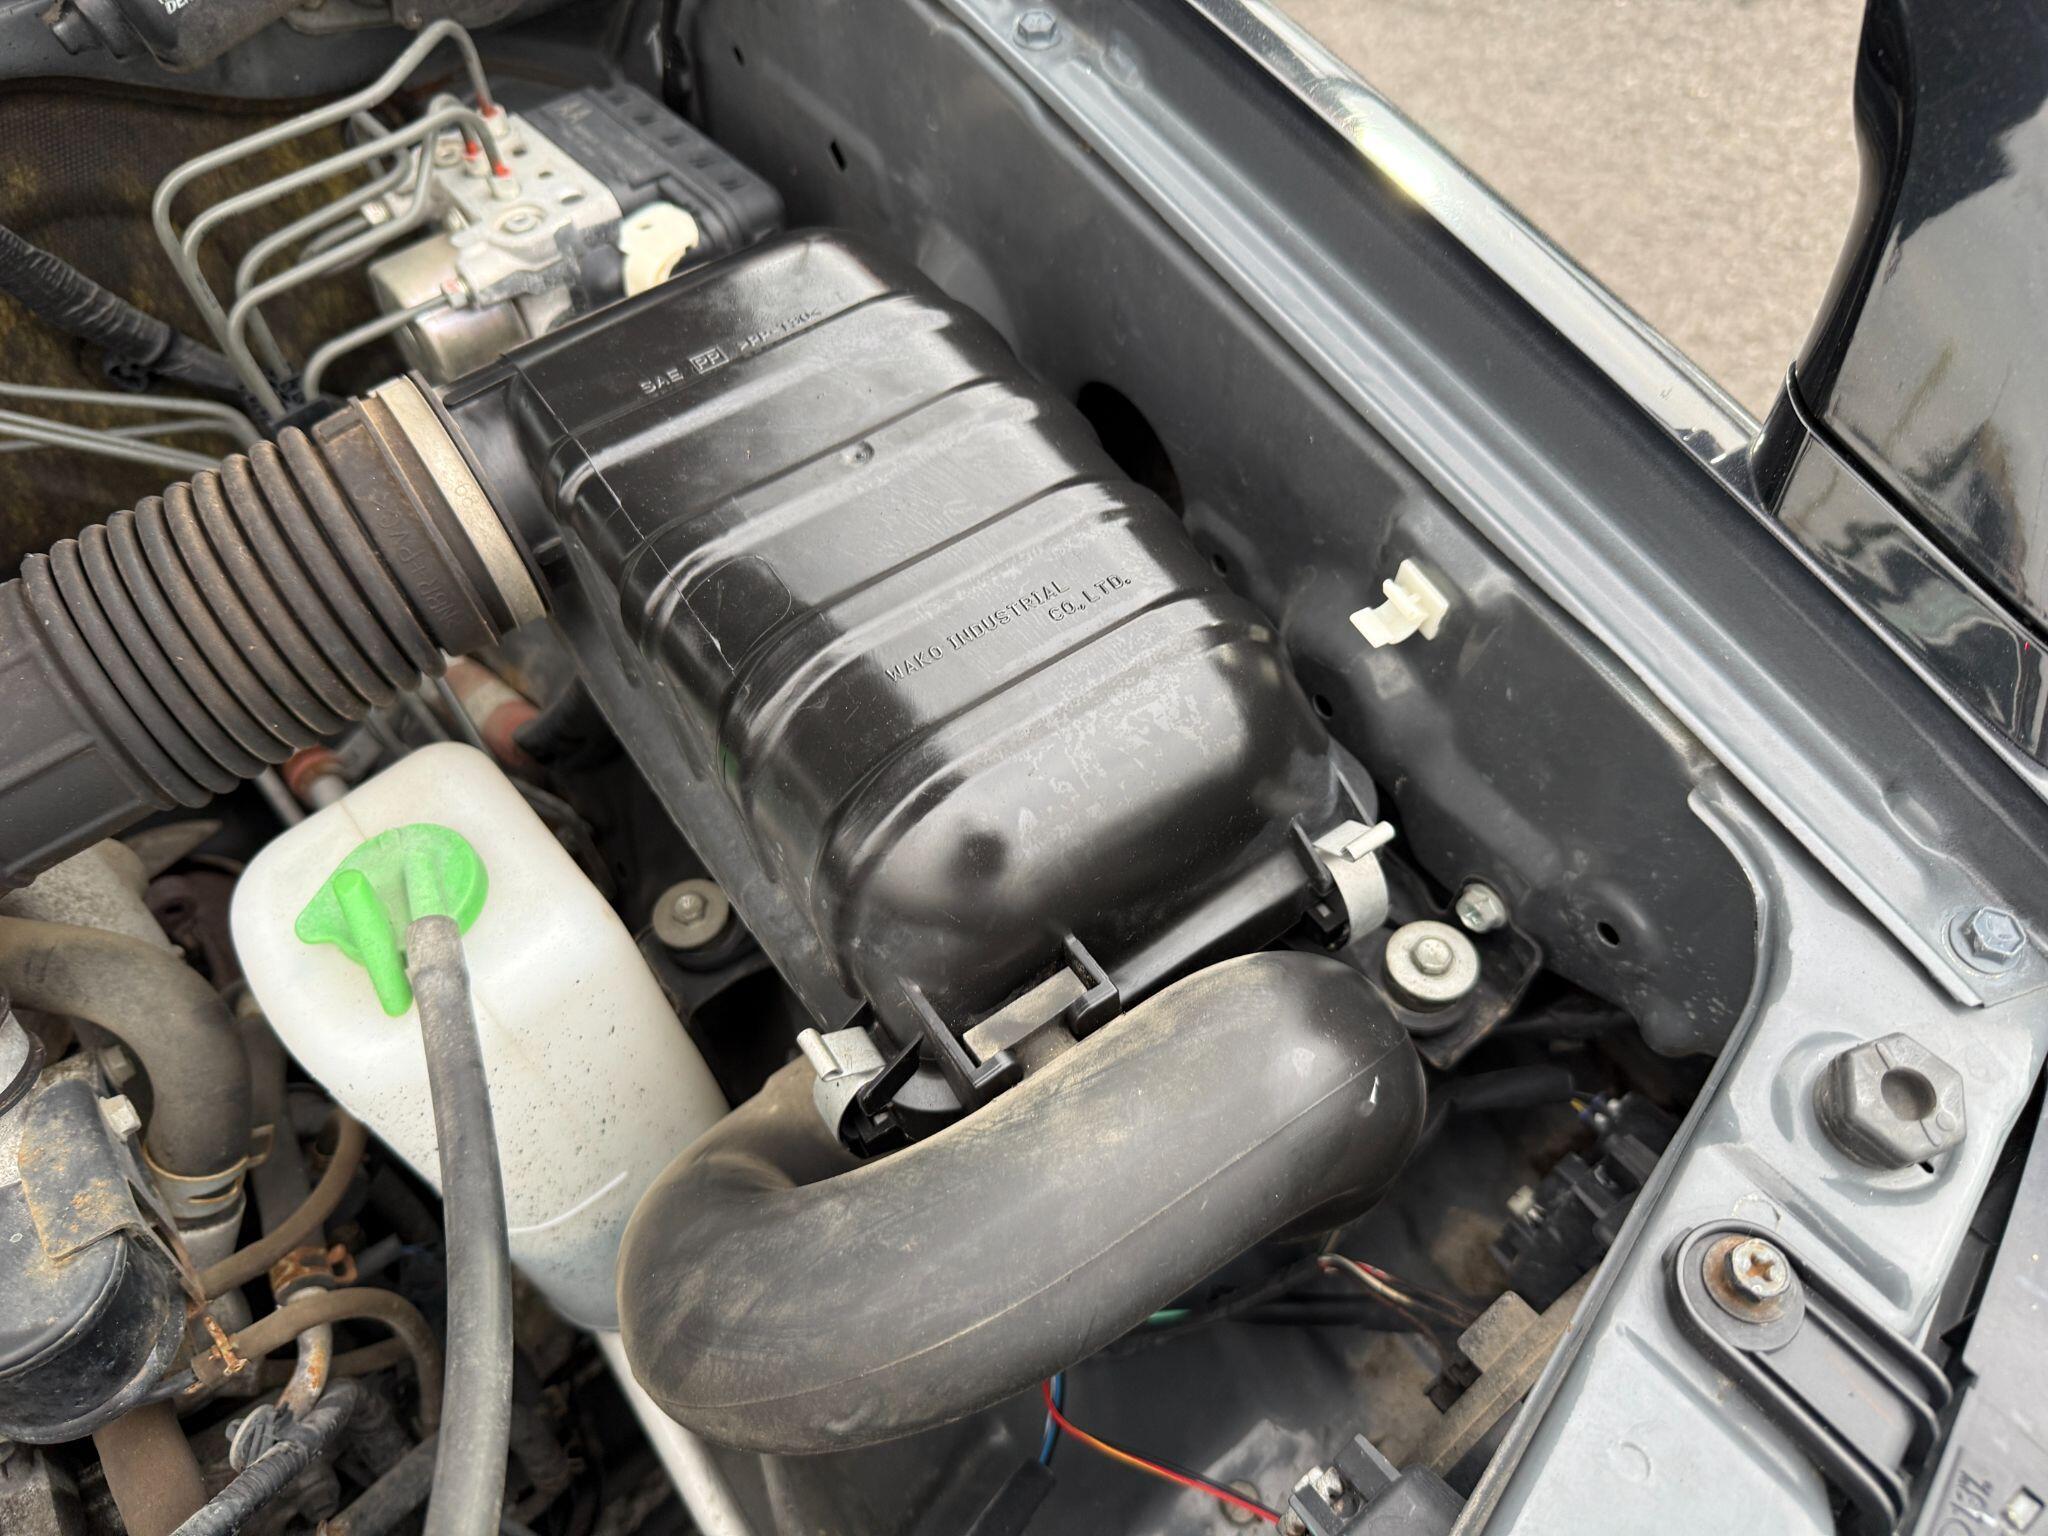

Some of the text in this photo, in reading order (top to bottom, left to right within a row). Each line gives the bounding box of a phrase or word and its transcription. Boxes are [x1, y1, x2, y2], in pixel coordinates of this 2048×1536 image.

[640, 367, 684, 395] SAE
[694, 350, 721, 371] PP
[885, 580, 1071, 684] WAKO INDUSTRIAL
